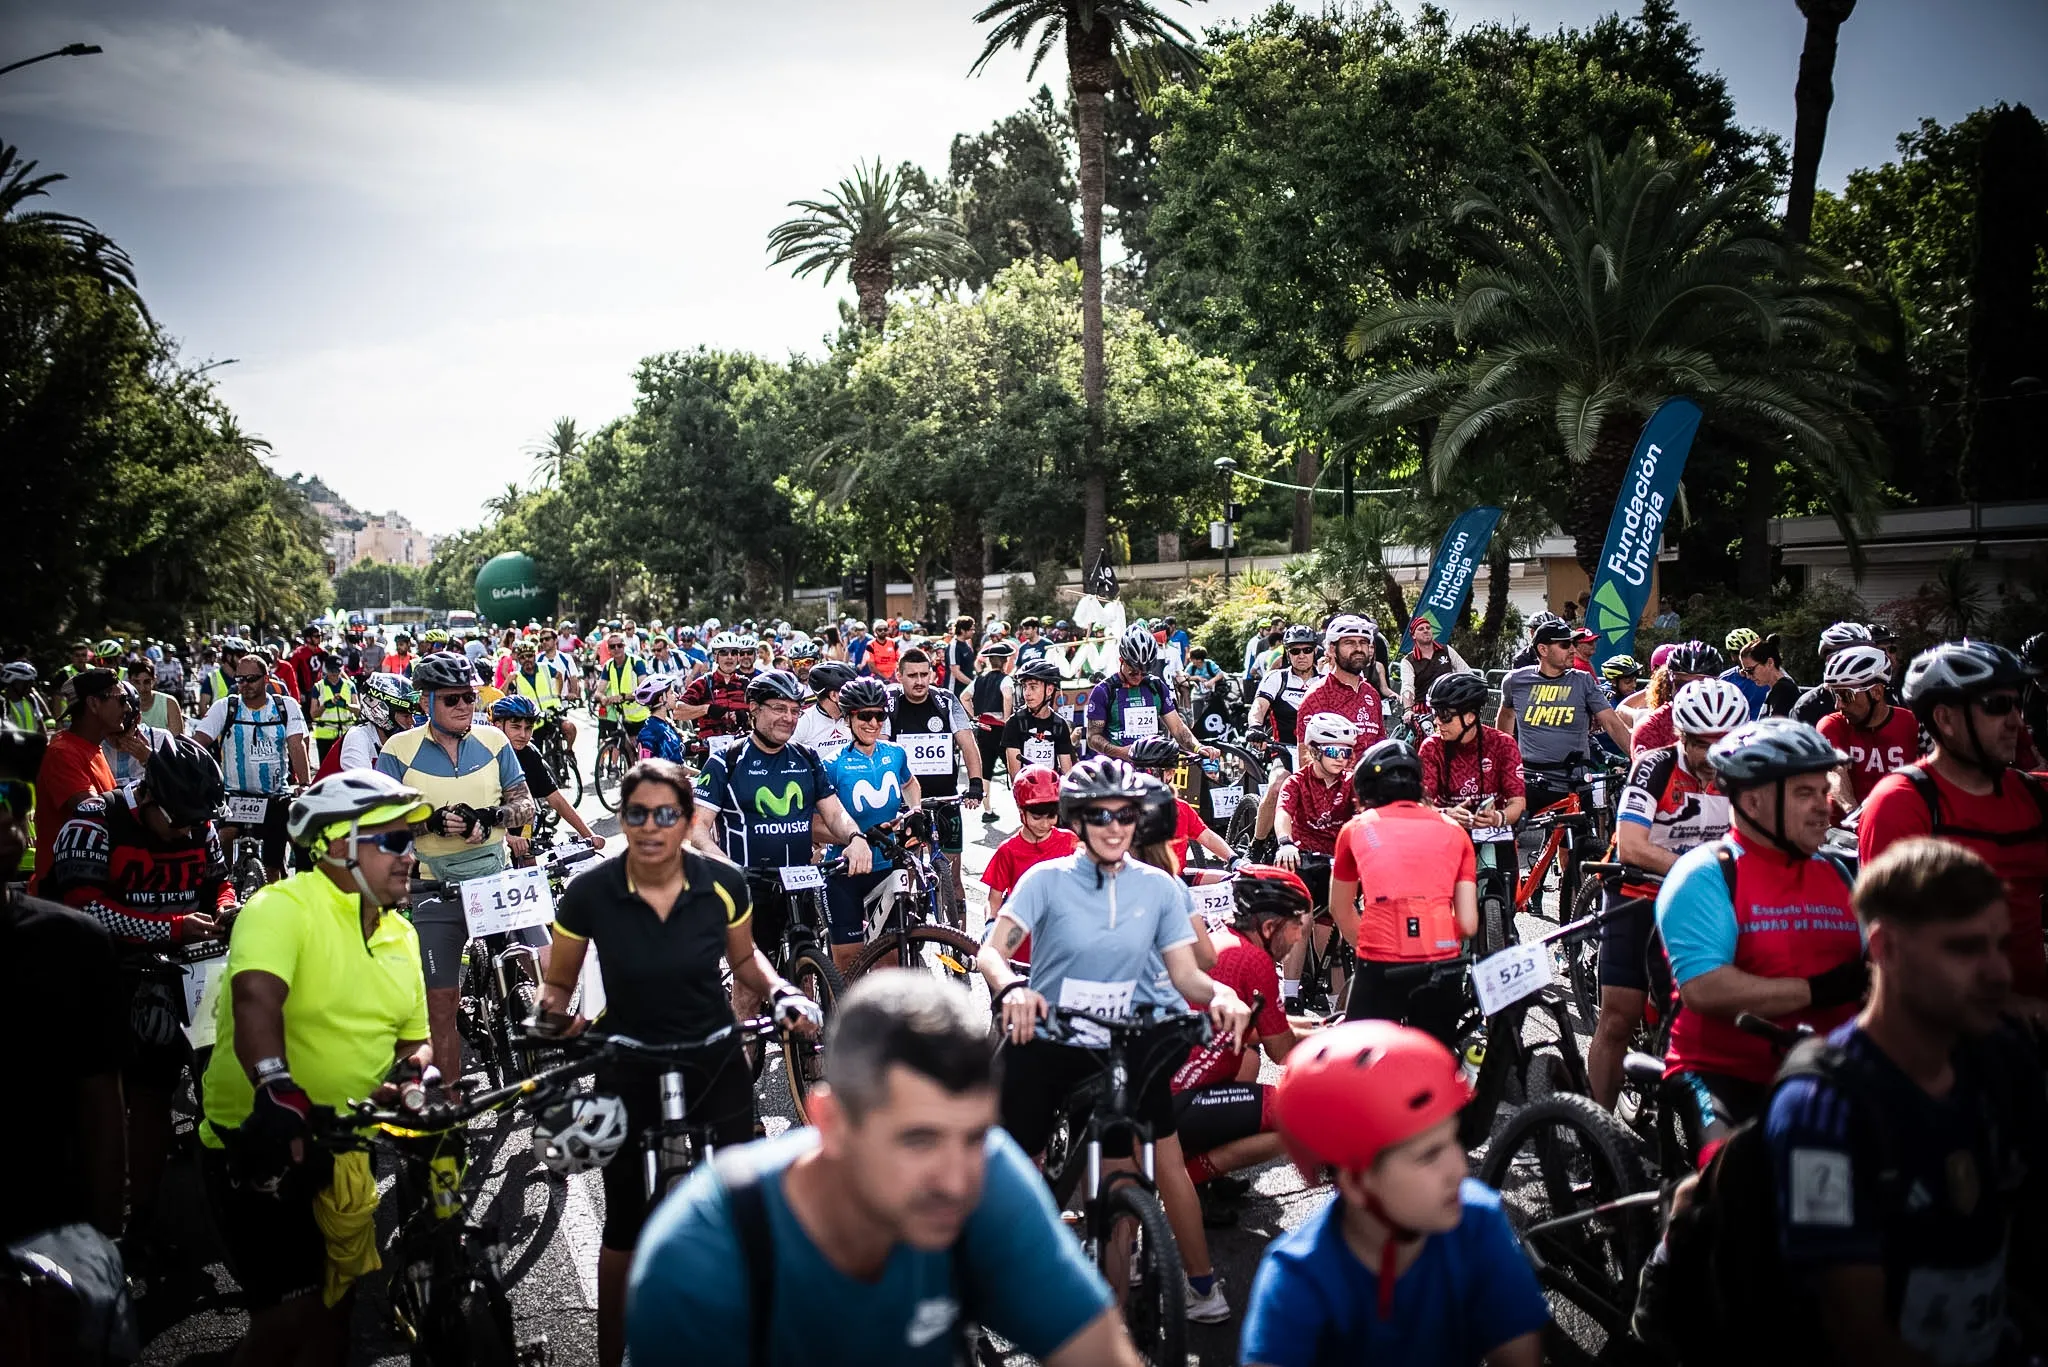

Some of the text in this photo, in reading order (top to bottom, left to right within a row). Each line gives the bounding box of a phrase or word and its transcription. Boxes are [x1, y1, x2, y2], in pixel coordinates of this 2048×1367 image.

[1607, 442, 1662, 577] Fundación
[1625, 491, 1665, 586] Unicaja
[1428, 531, 1469, 607] Fundación
[1440, 556, 1473, 610] Unicaja
[1137, 716, 1153, 726] 224
[1523, 705, 1576, 727] LIMITS
[914, 745, 946, 760] 866
[1035, 750, 1052, 759] 225
[1636, 750, 1671, 788] SOLFRIO
[1223, 794, 1240, 806] 743
[239, 804, 260, 813] 440
[754, 820, 810, 834] movistar
[71, 849, 87, 859] THE
[792, 872, 819, 883] 1067
[491, 884, 539, 911] 194
[1204, 894, 1231, 909] 522
[820, 890, 834, 924] movistar
[1499, 958, 1535, 985] 523
[1222, 1095, 1230, 1104] DE
[1230, 1094, 1255, 1103] MÁLAGA
